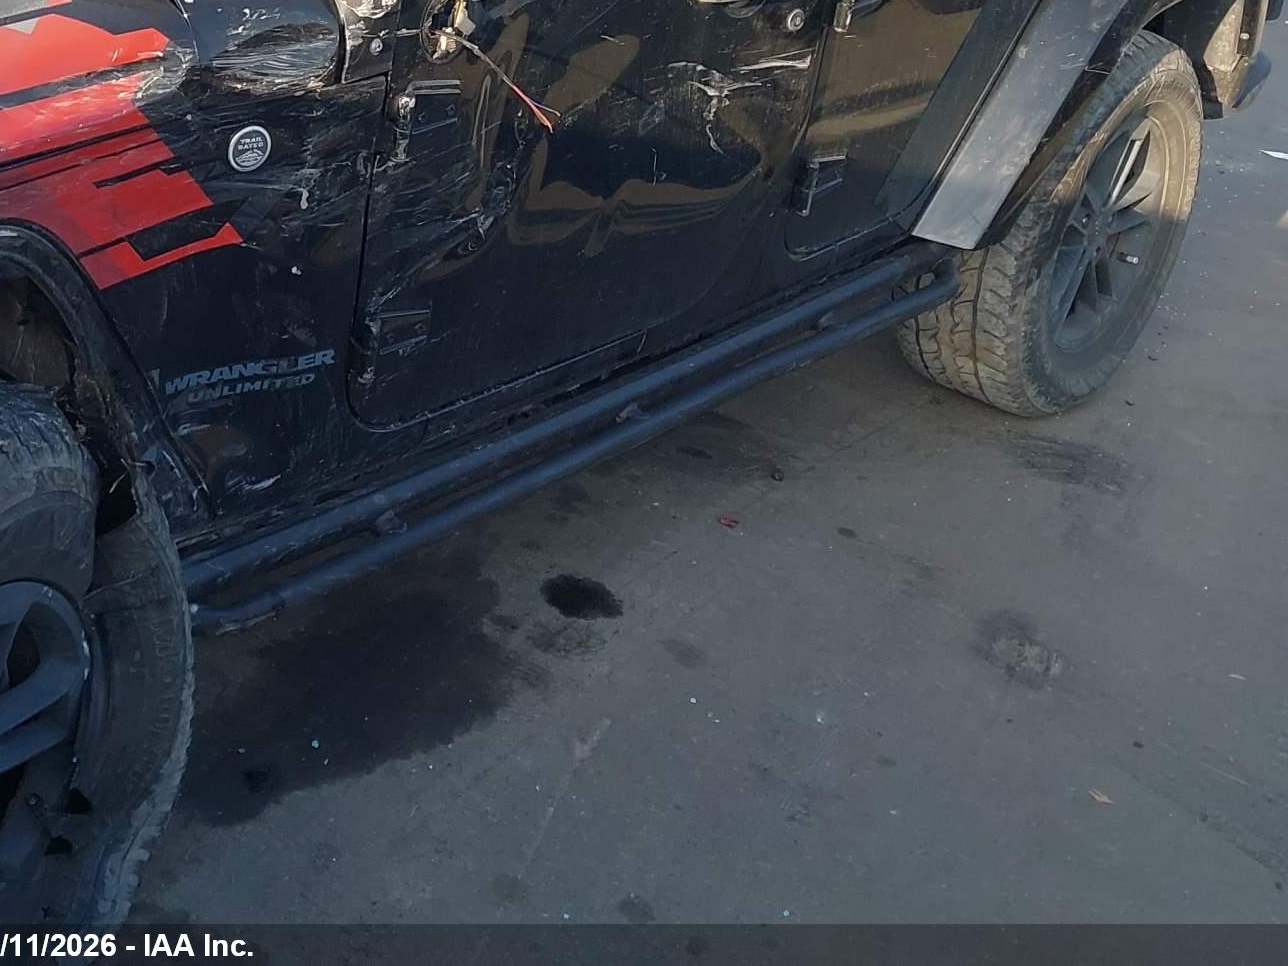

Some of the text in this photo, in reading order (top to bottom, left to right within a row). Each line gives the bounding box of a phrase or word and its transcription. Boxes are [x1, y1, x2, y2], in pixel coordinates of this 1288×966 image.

[237, 142, 264, 151] RATED
[239, 136, 264, 144] TRAIL
[165, 348, 336, 395] WRANGLER
[187, 373, 315, 403] UNLIMITED
